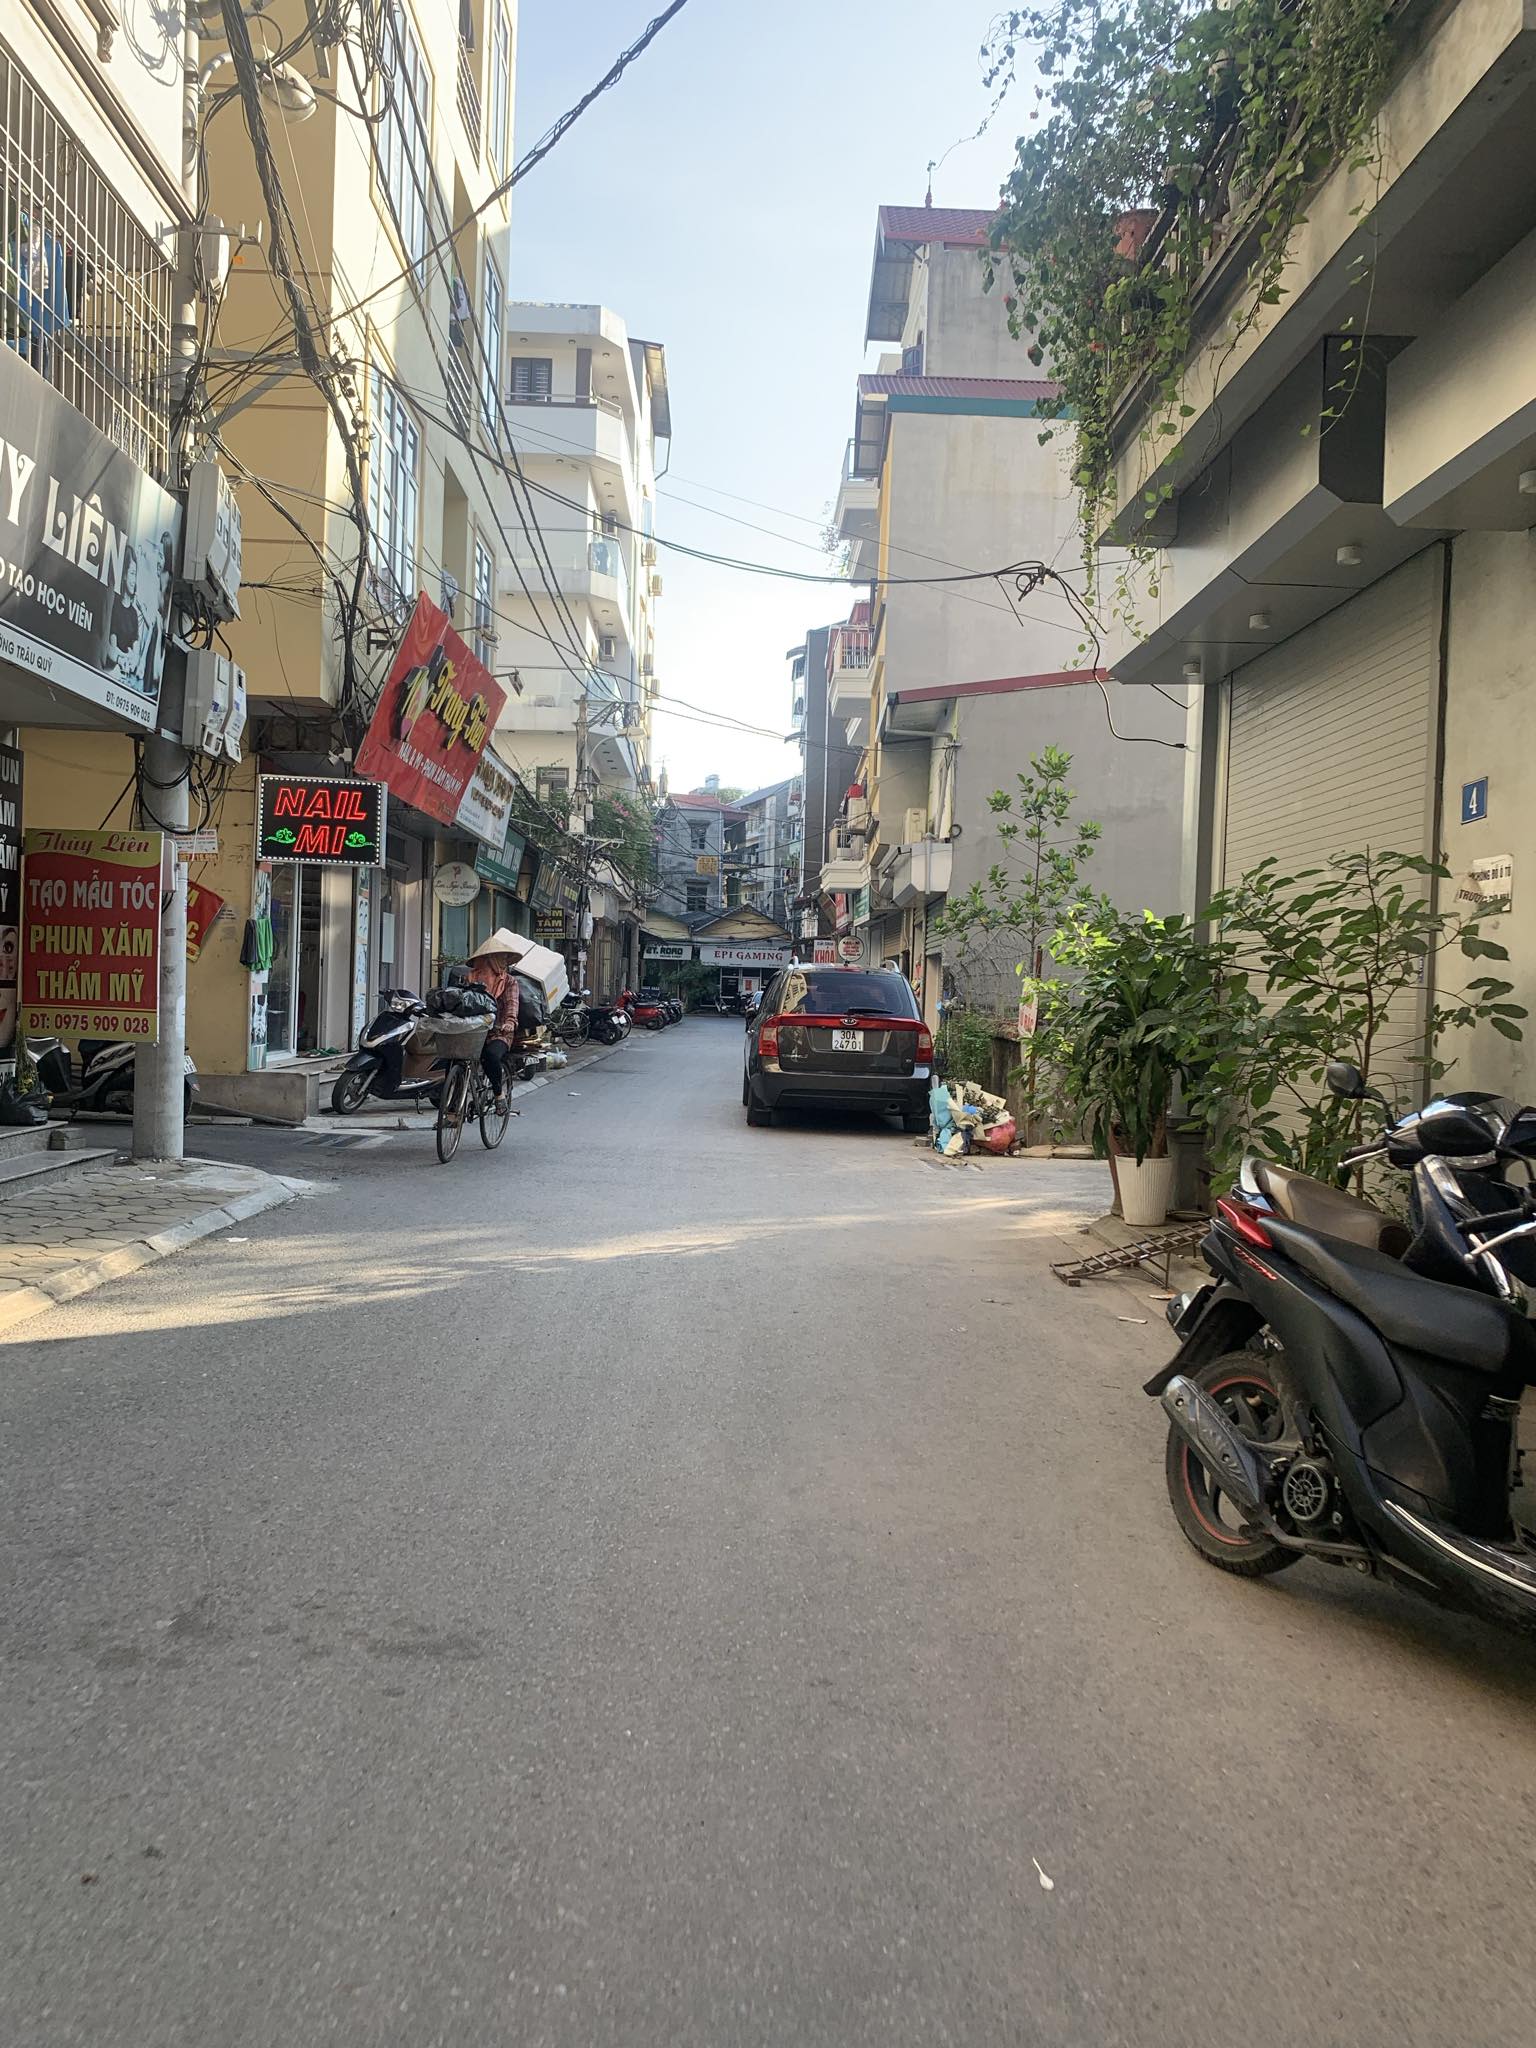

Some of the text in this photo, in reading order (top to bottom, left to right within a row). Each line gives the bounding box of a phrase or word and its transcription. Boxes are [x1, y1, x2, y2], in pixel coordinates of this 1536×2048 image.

[42, 475, 128, 594] LIÊN
[8, 563, 35, 597] TẠO
[37, 582, 66, 615] HỌC
[68, 599, 93, 632] VIÊN
[115, 695, 130, 713] 0975
[130, 703, 141, 718] 909
[274, 786, 368, 821] NAIL
[1469, 787, 1478, 815] 4
[101, 832, 151, 854] Liên
[293, 824, 347, 855] MI
[29, 878, 67, 917] TẠO
[72, 868, 113, 911] MẪU
[120, 875, 156, 911] TÓC
[29, 921, 153, 958] PHUN XĂM
[714, 950, 784, 961] EPI GAMING
[36, 960, 145, 1003] THẨM MỸ
[29, 1013, 150, 1034] ĐT: 0975 909 028
[840, 1030, 857, 1039] 30A
